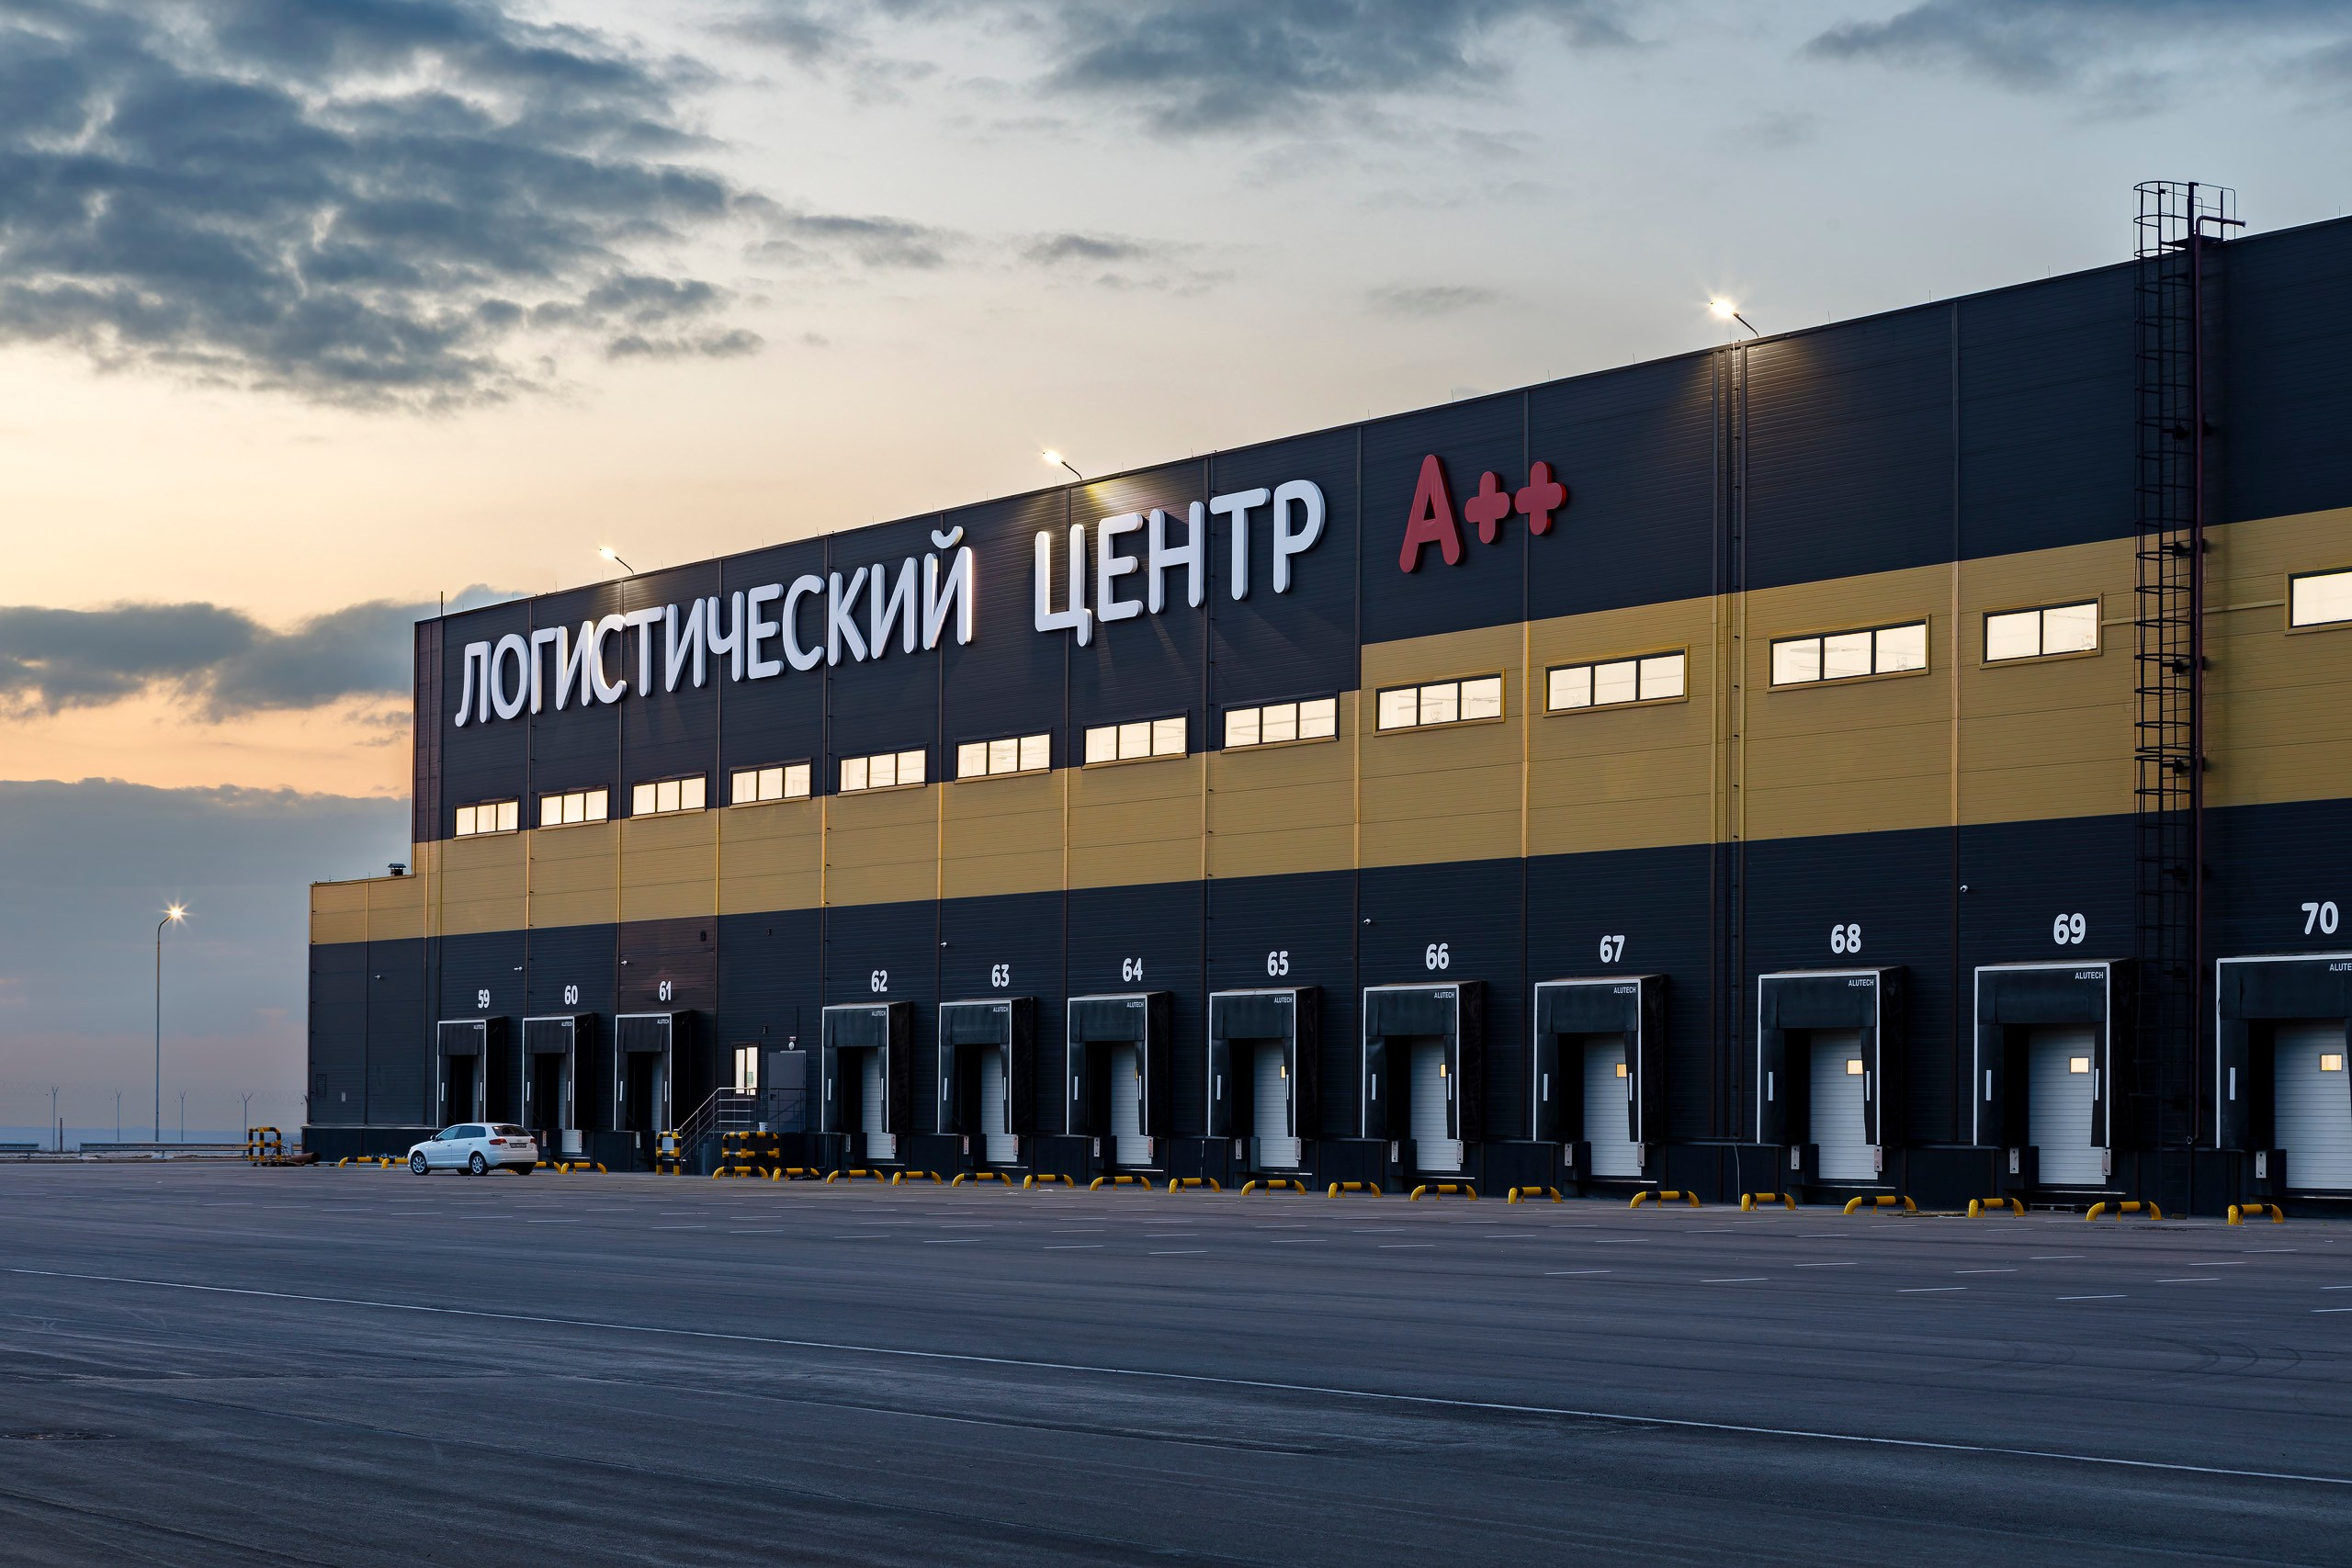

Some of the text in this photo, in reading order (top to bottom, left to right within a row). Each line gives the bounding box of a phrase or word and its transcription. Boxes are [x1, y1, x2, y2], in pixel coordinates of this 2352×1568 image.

[455, 525, 973, 728] ЛОГИСТИЧЕСКИЙ
[1035, 479, 1326, 647] ЦЕНТР
[2053, 913, 2086, 945] 69
[2301, 901, 2339, 935] 70
[1600, 934, 1625, 964] 67
[1830, 923, 1861, 954] 68
[1267, 951, 1289, 976] 65
[1425, 942, 1450, 970] 66
[871, 970, 888, 992] 62
[991, 964, 1010, 987] 63
[1122, 957, 1143, 982] 64
[2075, 971, 2104, 980] ALUTECH
[564, 985, 579, 1005] 60
[659, 980, 672, 1001] 61
[1849, 979, 1874, 987] ALUTECH
[478, 988, 491, 1009] 59
